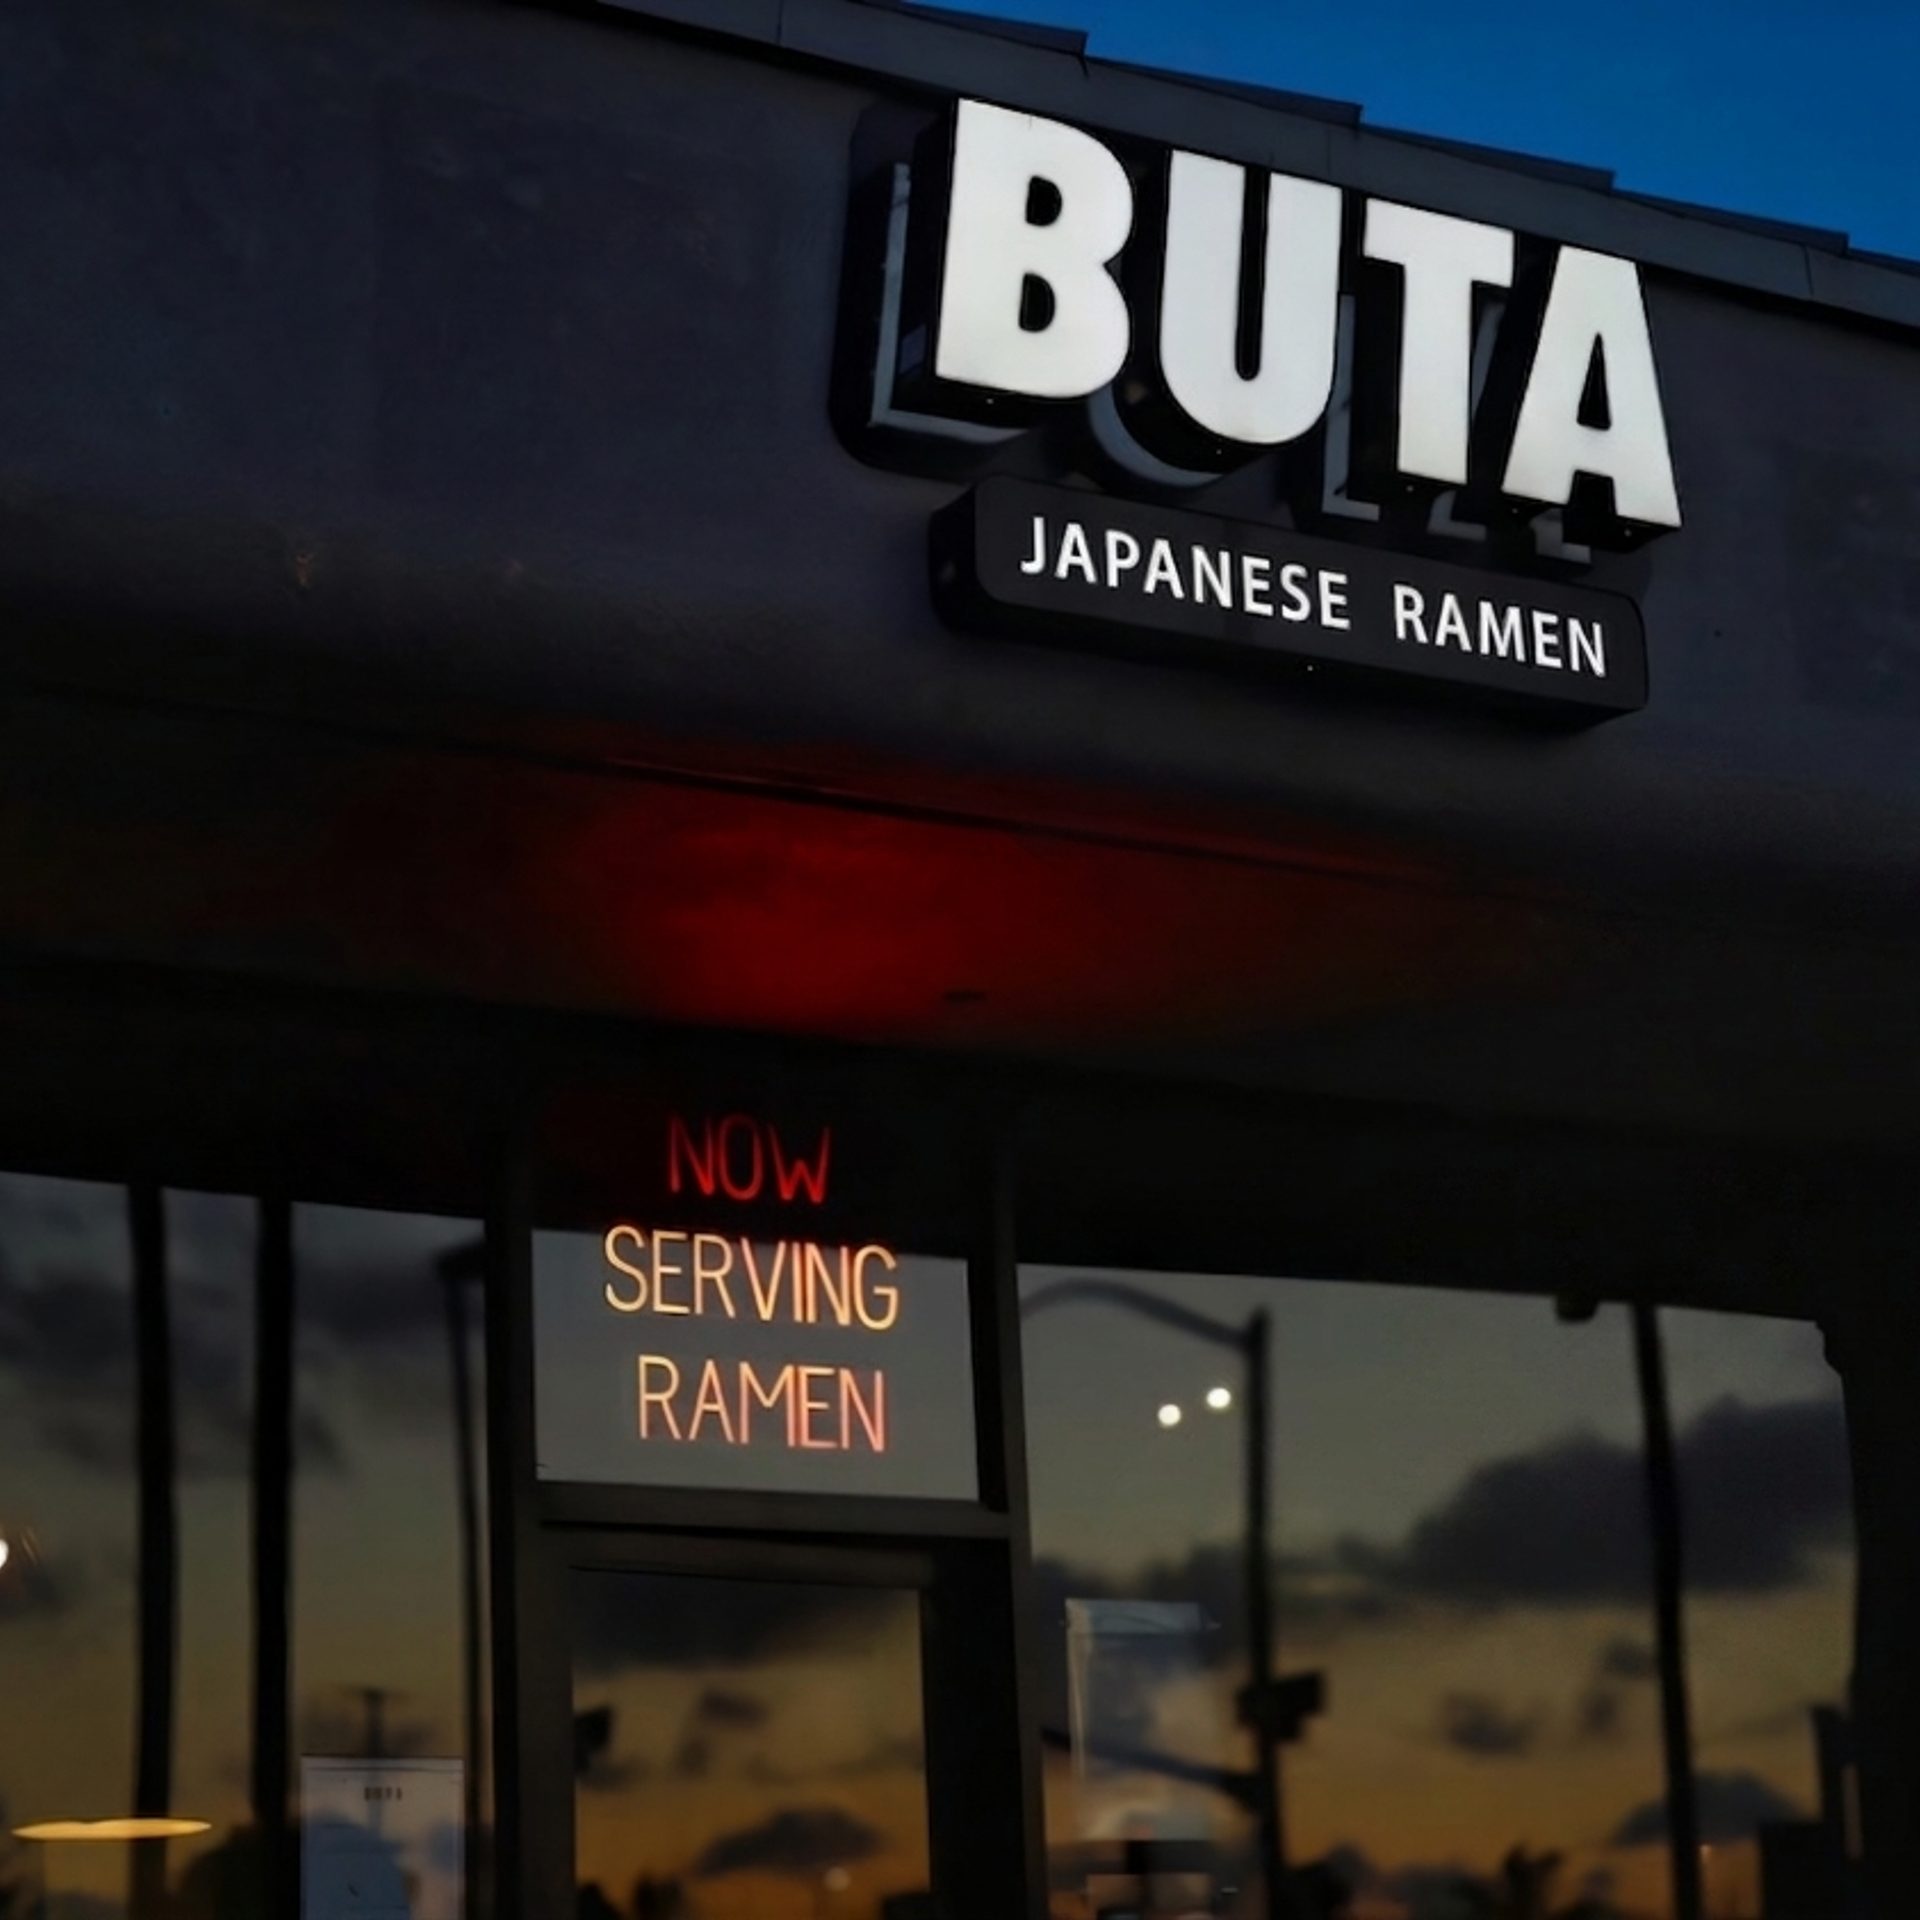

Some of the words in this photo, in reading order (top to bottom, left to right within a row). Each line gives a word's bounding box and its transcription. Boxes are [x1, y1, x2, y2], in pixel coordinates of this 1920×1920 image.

[936, 98, 1683, 529] BUTA
[1019, 515, 1352, 632] JAPANESE
[1394, 583, 1607, 679] RAMEN
[666, 1113, 833, 1206] NOW
[603, 1225, 900, 1332] SERVING
[636, 1354, 887, 1455] RAMEN
